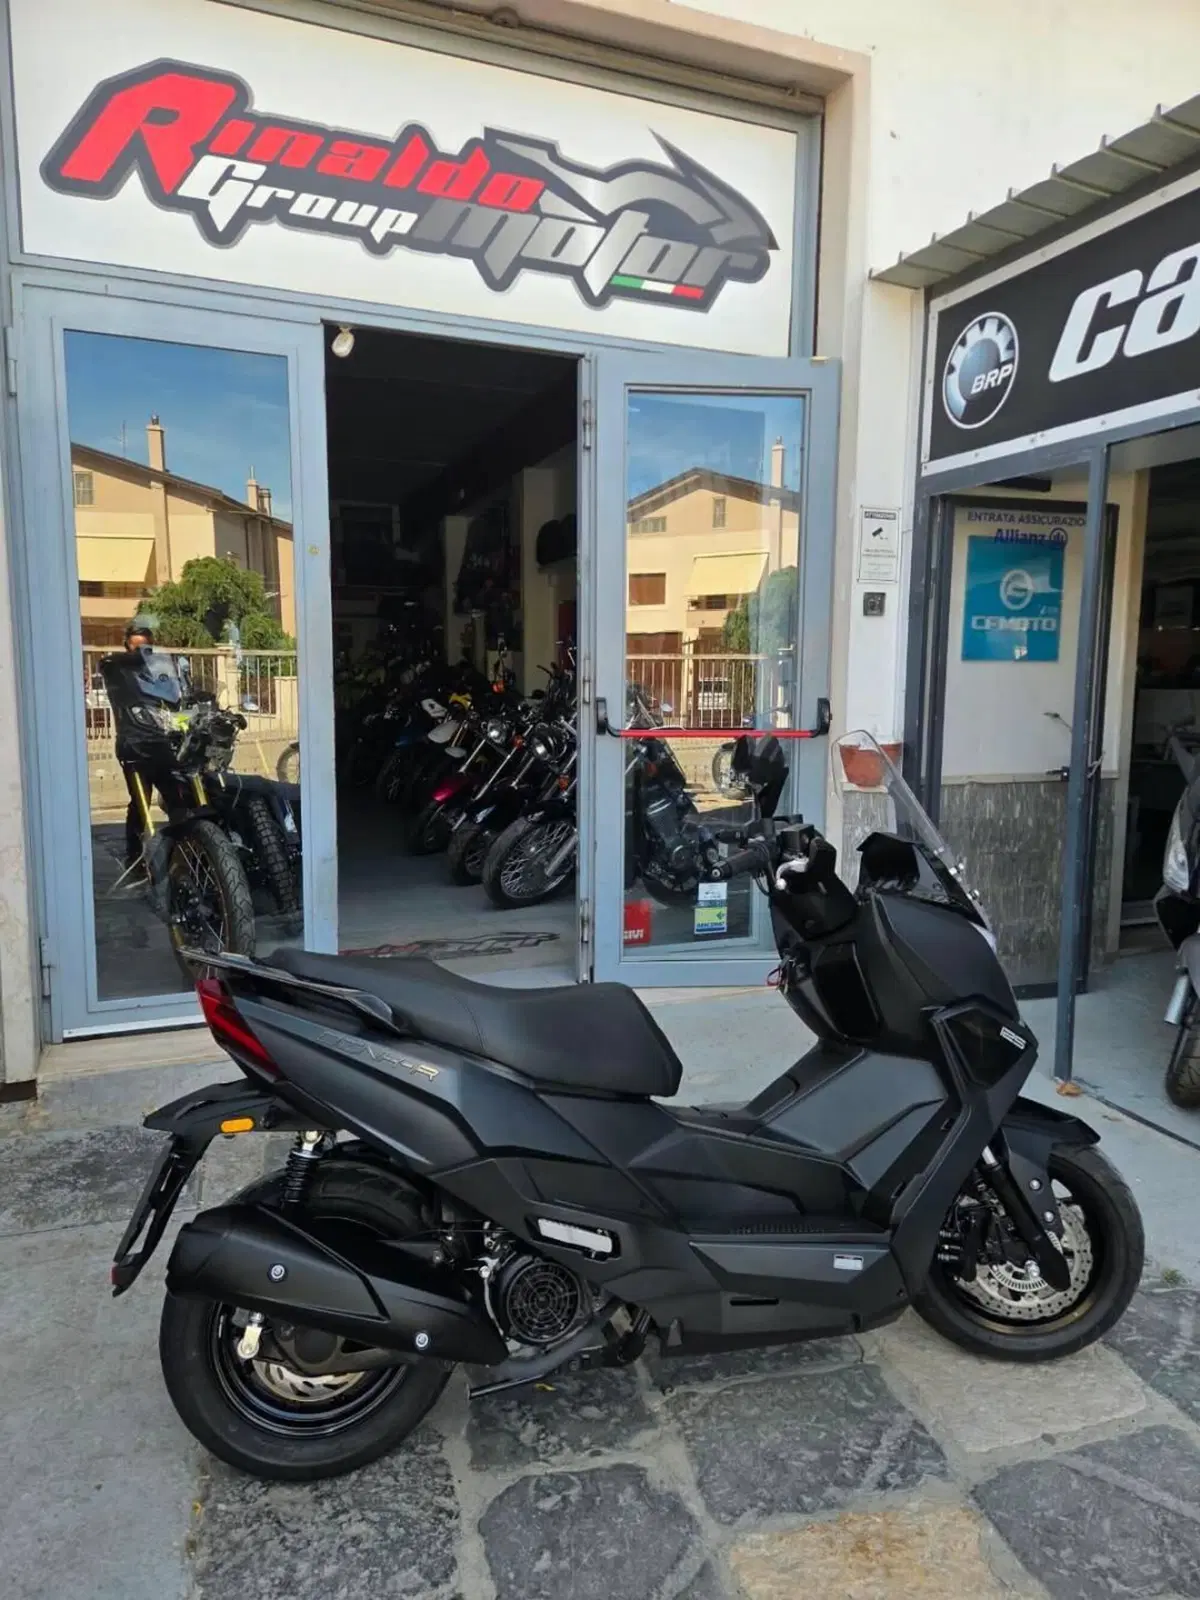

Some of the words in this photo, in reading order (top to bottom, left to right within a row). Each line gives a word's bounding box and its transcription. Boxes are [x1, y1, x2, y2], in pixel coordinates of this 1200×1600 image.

[60, 72, 546, 213] Rinaldo
[178, 154, 418, 235] Group
[970, 362, 1014, 395] BRP
[967, 511, 1016, 524] ENTRATA
[1019, 512, 1087, 527] ASSICURAZIO
[993, 527, 1049, 545] Allianz
